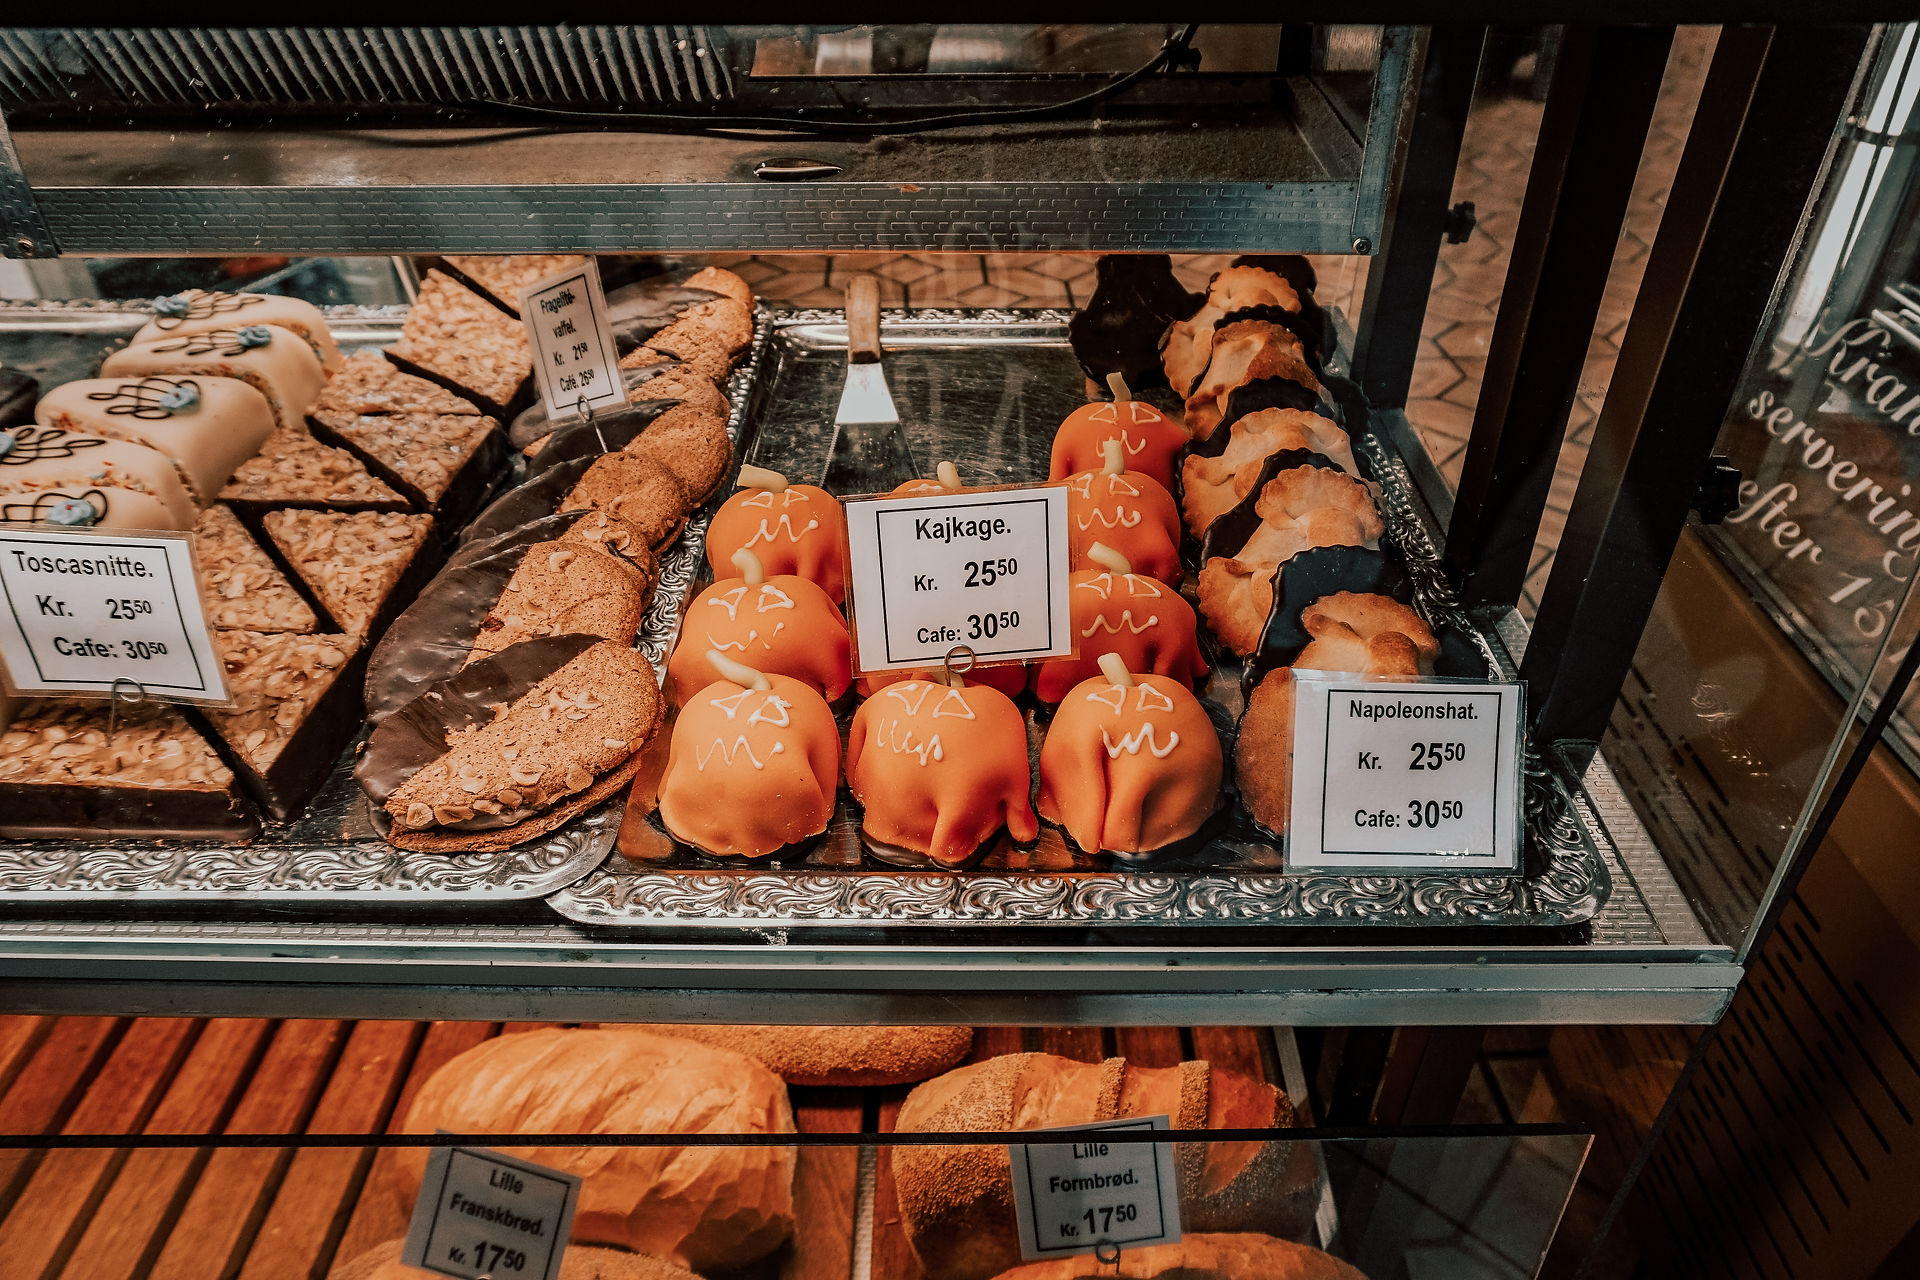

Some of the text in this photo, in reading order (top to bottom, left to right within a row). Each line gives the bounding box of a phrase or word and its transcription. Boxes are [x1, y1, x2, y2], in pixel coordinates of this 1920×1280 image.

[553, 351, 566, 367] Kr.
[914, 516, 1012, 544] Kajkage.
[11, 550, 154, 578] Toscasnitte.
[913, 557, 1018, 592] Kr. 2550
[35, 594, 153, 620] Kr. 2550
[916, 610, 1020, 644] Cafe: 3050
[53, 636, 168, 661] Cafe: 3050
[1349, 699, 1479, 722] Napoleonshat.
[1358, 742, 1466, 771] Kr. 2550
[1354, 799, 1464, 829] Cafe: 3050
[1072, 1143, 1109, 1160] Lille
[489, 1169, 525, 1194] Lille
[1049, 1168, 1139, 1193] Formbrød.
[449, 1193, 544, 1237] Franskbrød.
[1060, 1203, 1137, 1238] Kr. 1750
[448, 1240, 527, 1273] Kr. 1750
